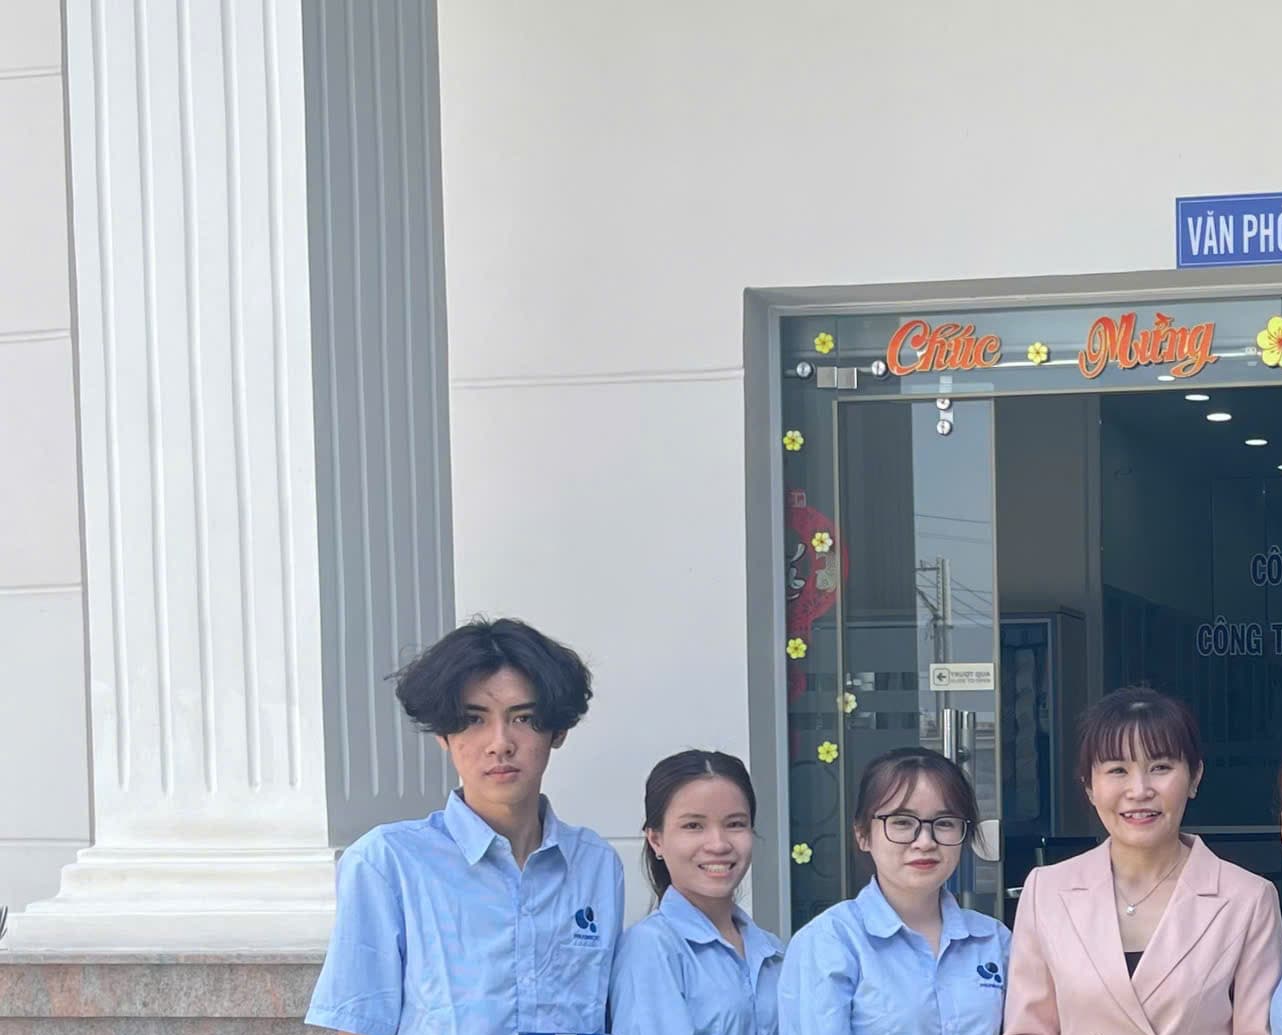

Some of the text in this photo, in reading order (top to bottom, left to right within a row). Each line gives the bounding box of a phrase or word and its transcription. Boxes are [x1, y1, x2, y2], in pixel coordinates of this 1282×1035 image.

[1187, 210, 1234, 256] VĂN
[886, 319, 1002, 376] Chúc
[1078, 311, 1218, 380] Mừng
[1196, 615, 1263, 656] CÔNG
